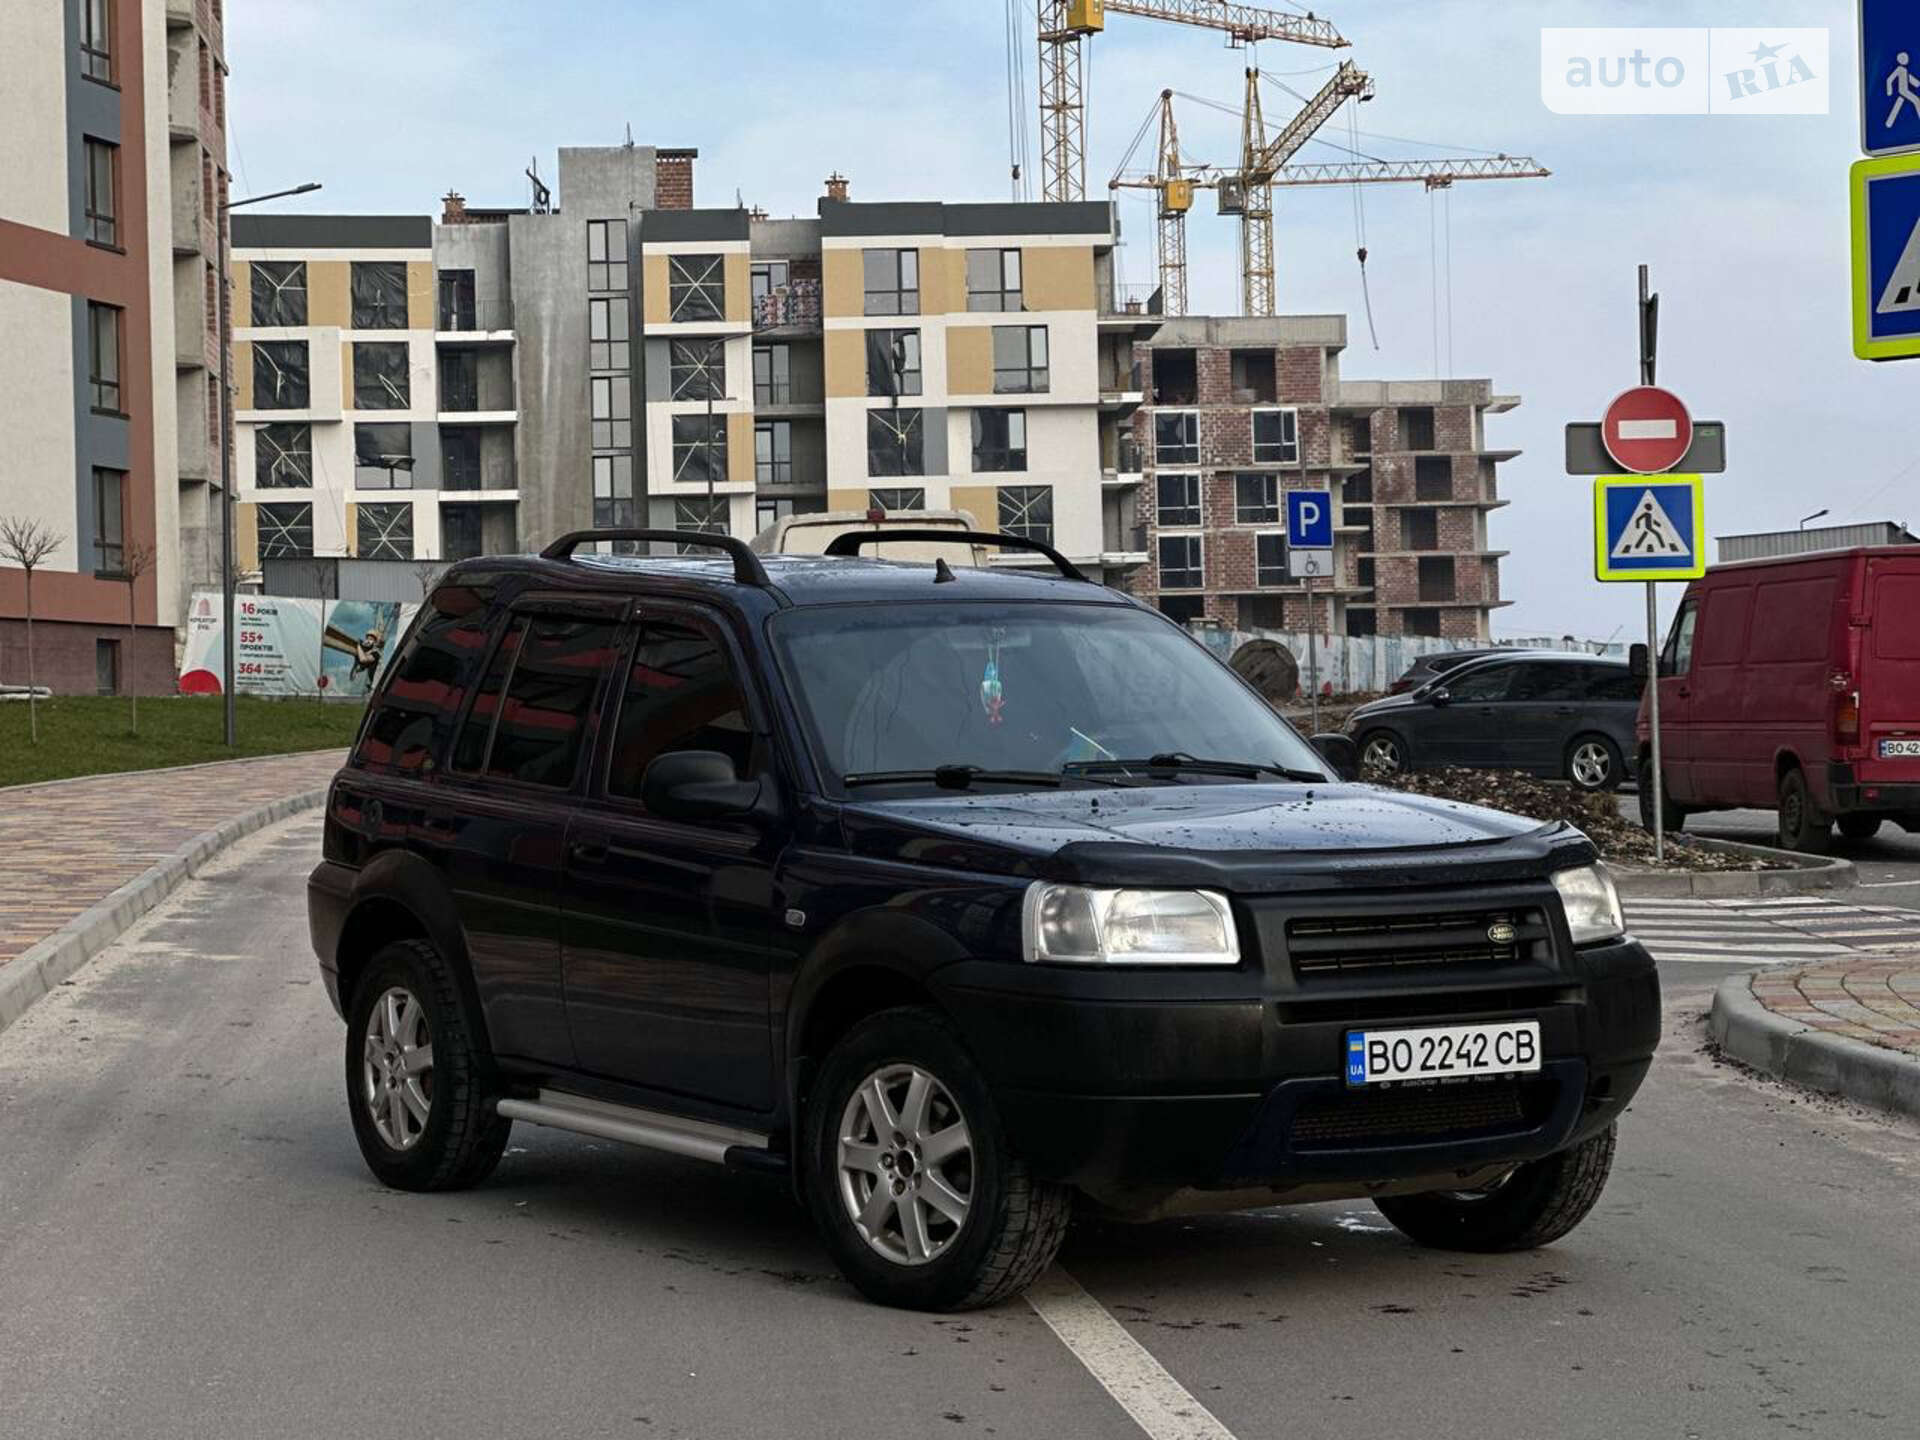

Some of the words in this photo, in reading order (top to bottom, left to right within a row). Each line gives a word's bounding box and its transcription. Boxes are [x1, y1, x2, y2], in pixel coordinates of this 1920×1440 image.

[1299, 501, 1321, 537] P
[241, 603, 255, 615] 16
[240, 631, 264, 643] 55+
[239, 662, 262, 674] 364
[1887, 743, 1904, 754] BO
[1368, 1038, 1412, 1076] BO
[1419, 1032, 1489, 1072] 2242
[1495, 1029, 1536, 1065] CB
[1350, 1064, 1364, 1076] UA
